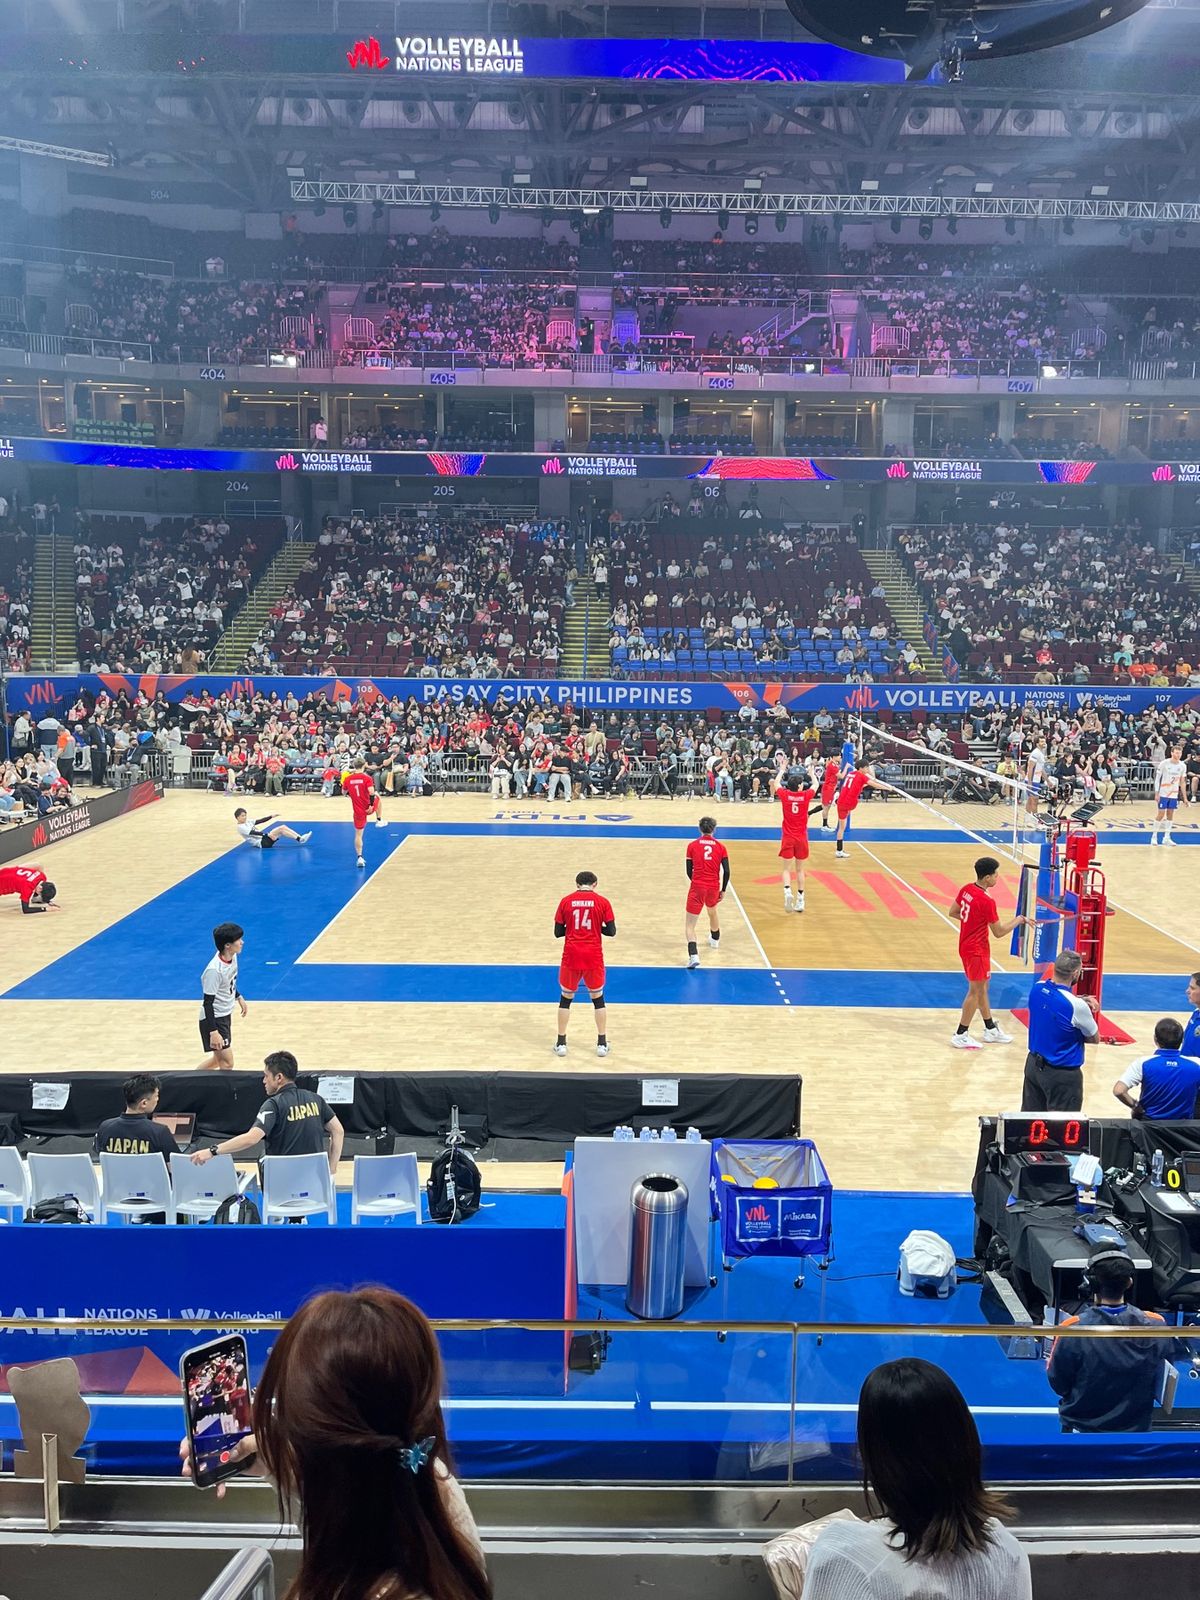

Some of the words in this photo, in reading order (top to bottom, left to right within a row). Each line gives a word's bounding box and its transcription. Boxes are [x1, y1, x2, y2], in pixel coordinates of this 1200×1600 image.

[395, 37, 524, 57] VOLLEYBALL
[396, 57, 462, 71] NATIONS
[467, 58, 524, 72] LEAGUE
[200, 368, 225, 380] 404
[432, 374, 455, 384] 405
[709, 378, 734, 389] 406
[1008, 381, 1033, 392] 407
[302, 453, 372, 463] VOLLEYBALL
[568, 457, 637, 467] VOLLEYBALL
[302, 463, 338, 471] NATIONS
[341, 464, 372, 472] LEAGUE
[606, 468, 637, 476] LEAGUE
[913, 461, 982, 471] VOLLEYBALL
[226, 481, 249, 491] 204
[433, 485, 455, 496] 205
[356, 685, 373, 693] 105
[423, 684, 492, 702] PASAY
[499, 685, 550, 702] CITY
[558, 686, 693, 704] PHILIPPINES
[733, 690, 749, 698] 106
[1024, 691, 1065, 699] NATIONS
[884, 690, 1021, 707] VOLLEYBALL
[1094, 694, 1131, 703] Volleyball
[1155, 694, 1171, 702] 107
[791, 802, 799, 814] 6
[48, 806, 90, 830] VOLLEYBALL
[49, 825, 72, 841] NATIONS
[72, 818, 91, 832] LEAGUE
[703, 845, 713, 860] 2
[960, 899, 970, 923] 23
[572, 909, 592, 930] 14
[287, 1101, 319, 1122] JAPAN
[1064, 1120, 1081, 1144] 0
[106, 1138, 150, 1154] JAPAN
[1167, 1169, 1180, 1188] 0
[84, 1308, 157, 1320] NATIONS
[0, 1307, 77, 1335] ALL
